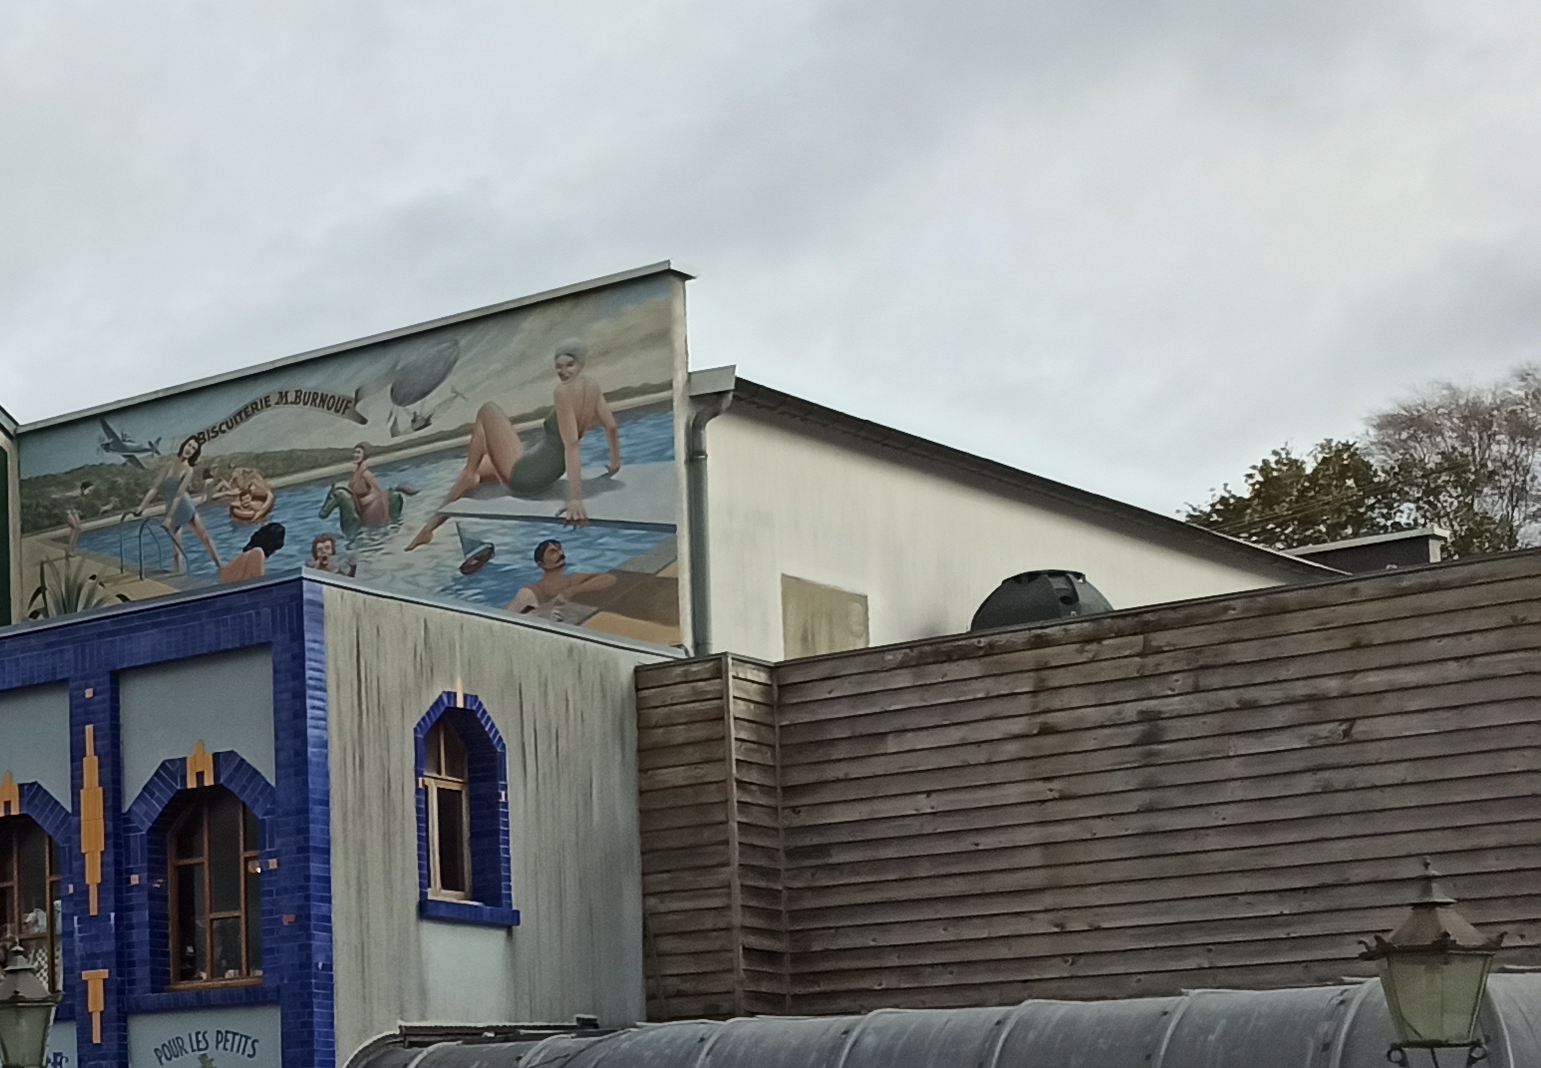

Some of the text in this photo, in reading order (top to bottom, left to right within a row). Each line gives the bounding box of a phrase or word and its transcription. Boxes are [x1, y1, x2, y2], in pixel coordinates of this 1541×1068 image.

[196, 395, 272, 446] BISCUITERIE
[153, 1029, 260, 1067] POUR LES PETITS
